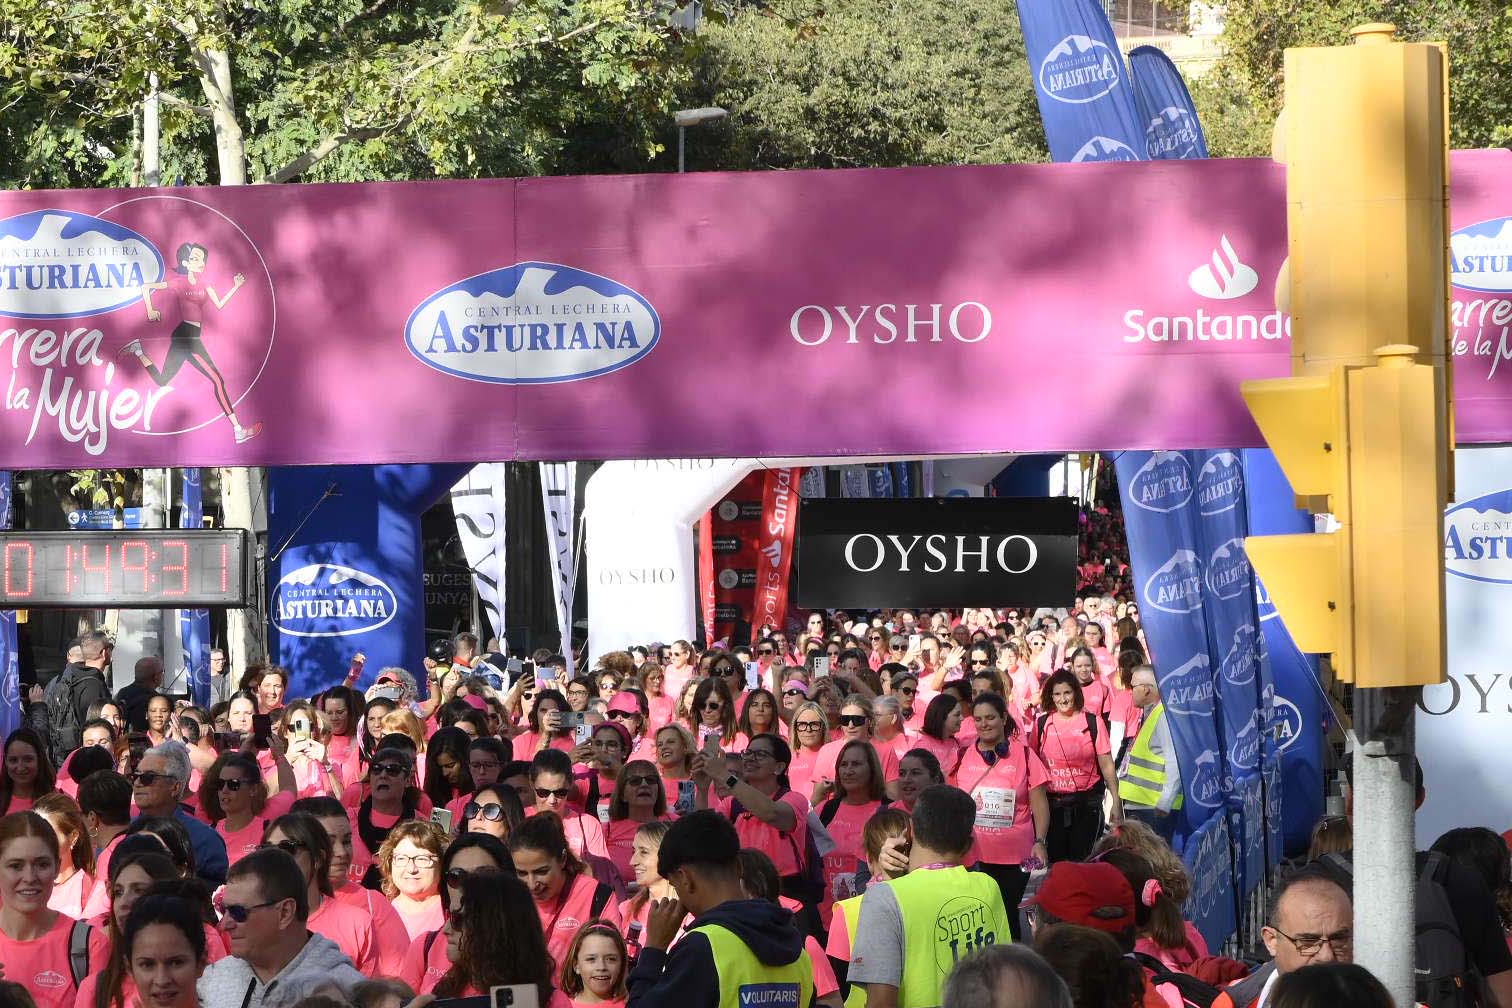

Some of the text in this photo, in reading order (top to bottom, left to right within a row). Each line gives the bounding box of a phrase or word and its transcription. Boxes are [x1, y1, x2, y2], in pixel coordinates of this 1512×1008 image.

[67, 246, 139, 257] LECHERA
[464, 303, 631, 319] CENTRAL LECHERA
[790, 301, 992, 345] OYSHO
[425, 310, 641, 354] ASTURIANA
[1474, 329, 1491, 356] la
[6, 371, 29, 410] la
[25, 363, 174, 455] Mujer
[4, 541, 227, 597] 01:49:31
[844, 533, 1038, 574] OYSHO
[287, 588, 383, 598] CENTRAL LECHERA
[599, 567, 675, 585] OYSHO
[275, 594, 388, 620] ASTURIANA
[1416, 673, 1512, 716] OY
[938, 903, 985, 942] Sport
